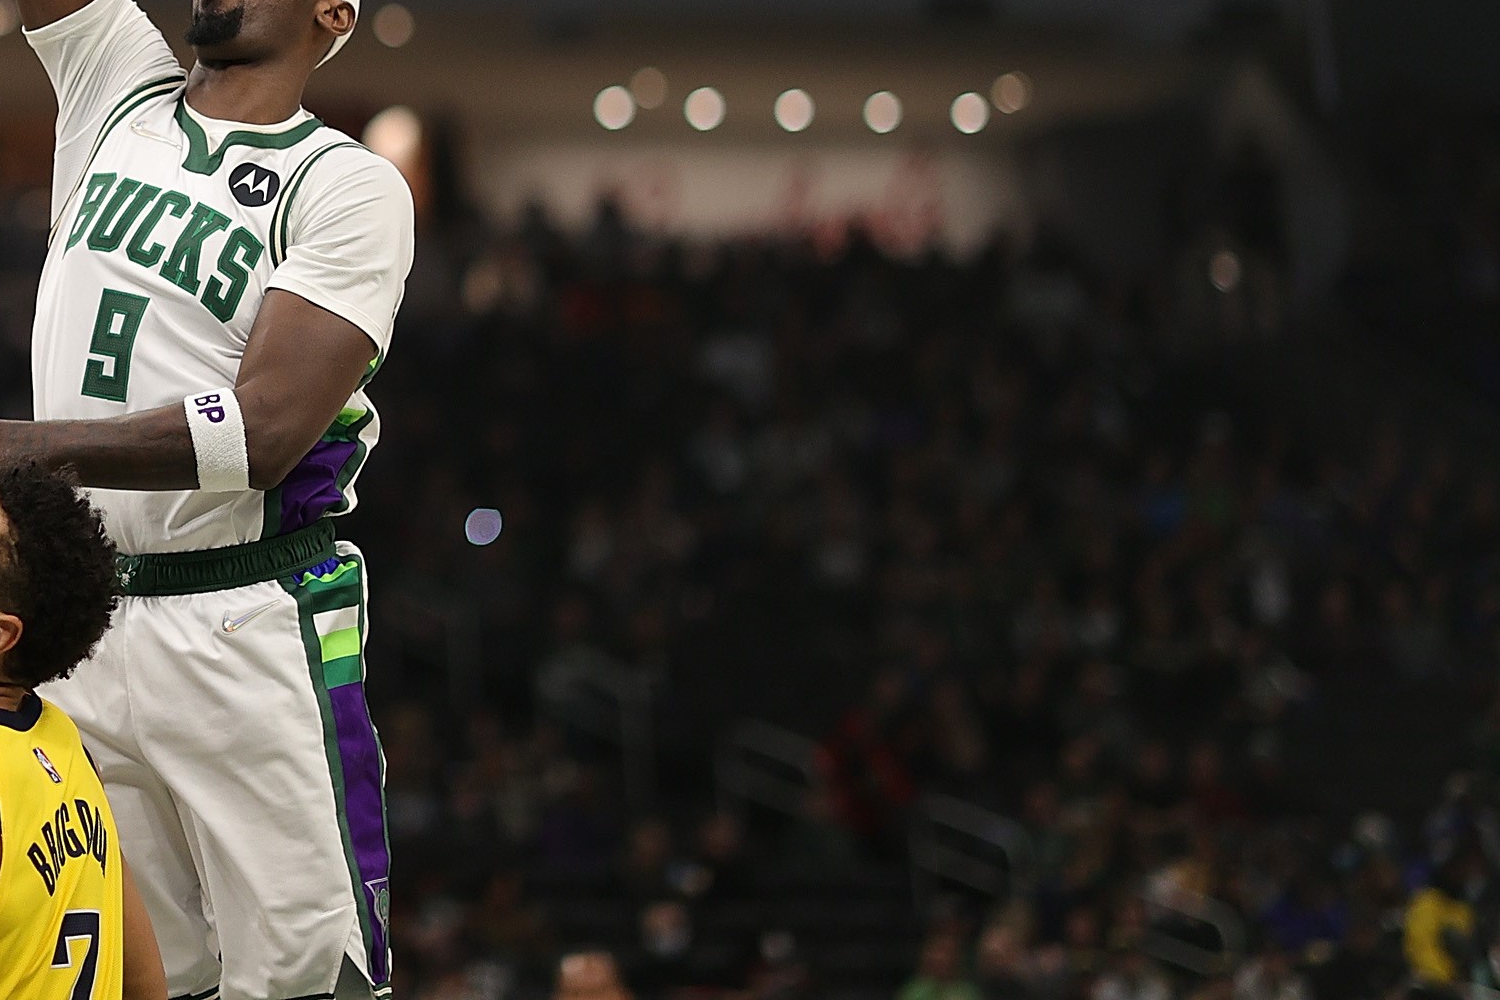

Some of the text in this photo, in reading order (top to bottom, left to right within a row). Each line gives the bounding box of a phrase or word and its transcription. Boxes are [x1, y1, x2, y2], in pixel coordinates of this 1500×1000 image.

[62, 172, 265, 324] BUCKS
[81, 288, 151, 403] 9
[194, 393, 226, 424] BP
[51, 910, 100, 1000] 7
